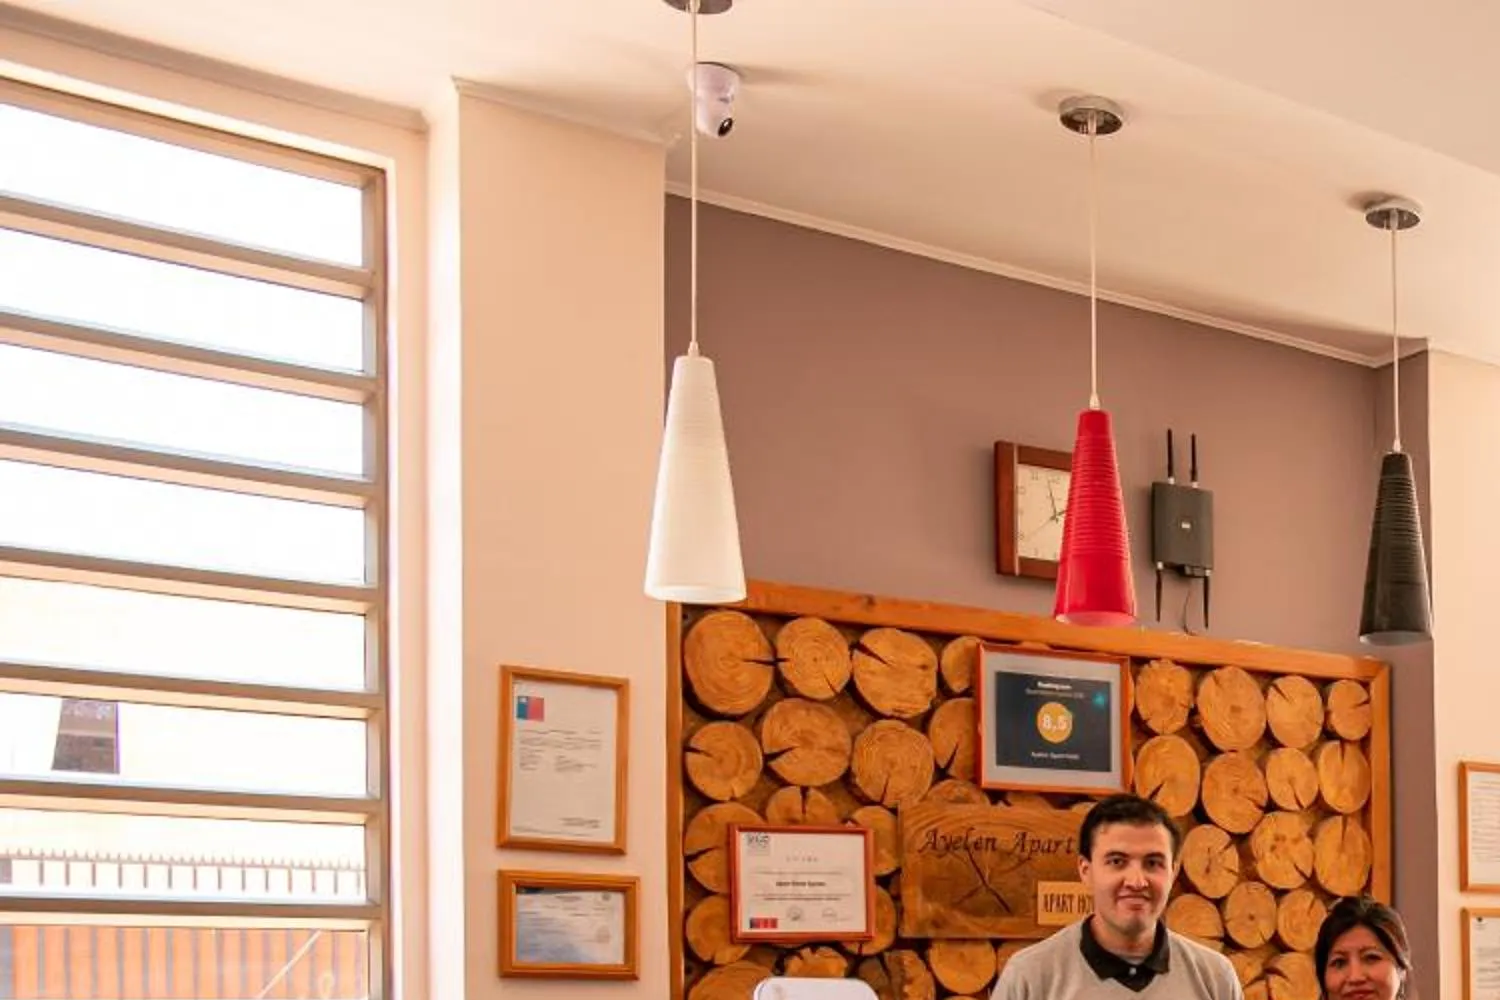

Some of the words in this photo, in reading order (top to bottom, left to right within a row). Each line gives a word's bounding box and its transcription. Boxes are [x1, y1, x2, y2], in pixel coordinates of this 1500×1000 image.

[918, 827, 997, 858] Ayelen
[1007, 831, 1075, 861] Apart
[1041, 893, 1075, 914] APART
